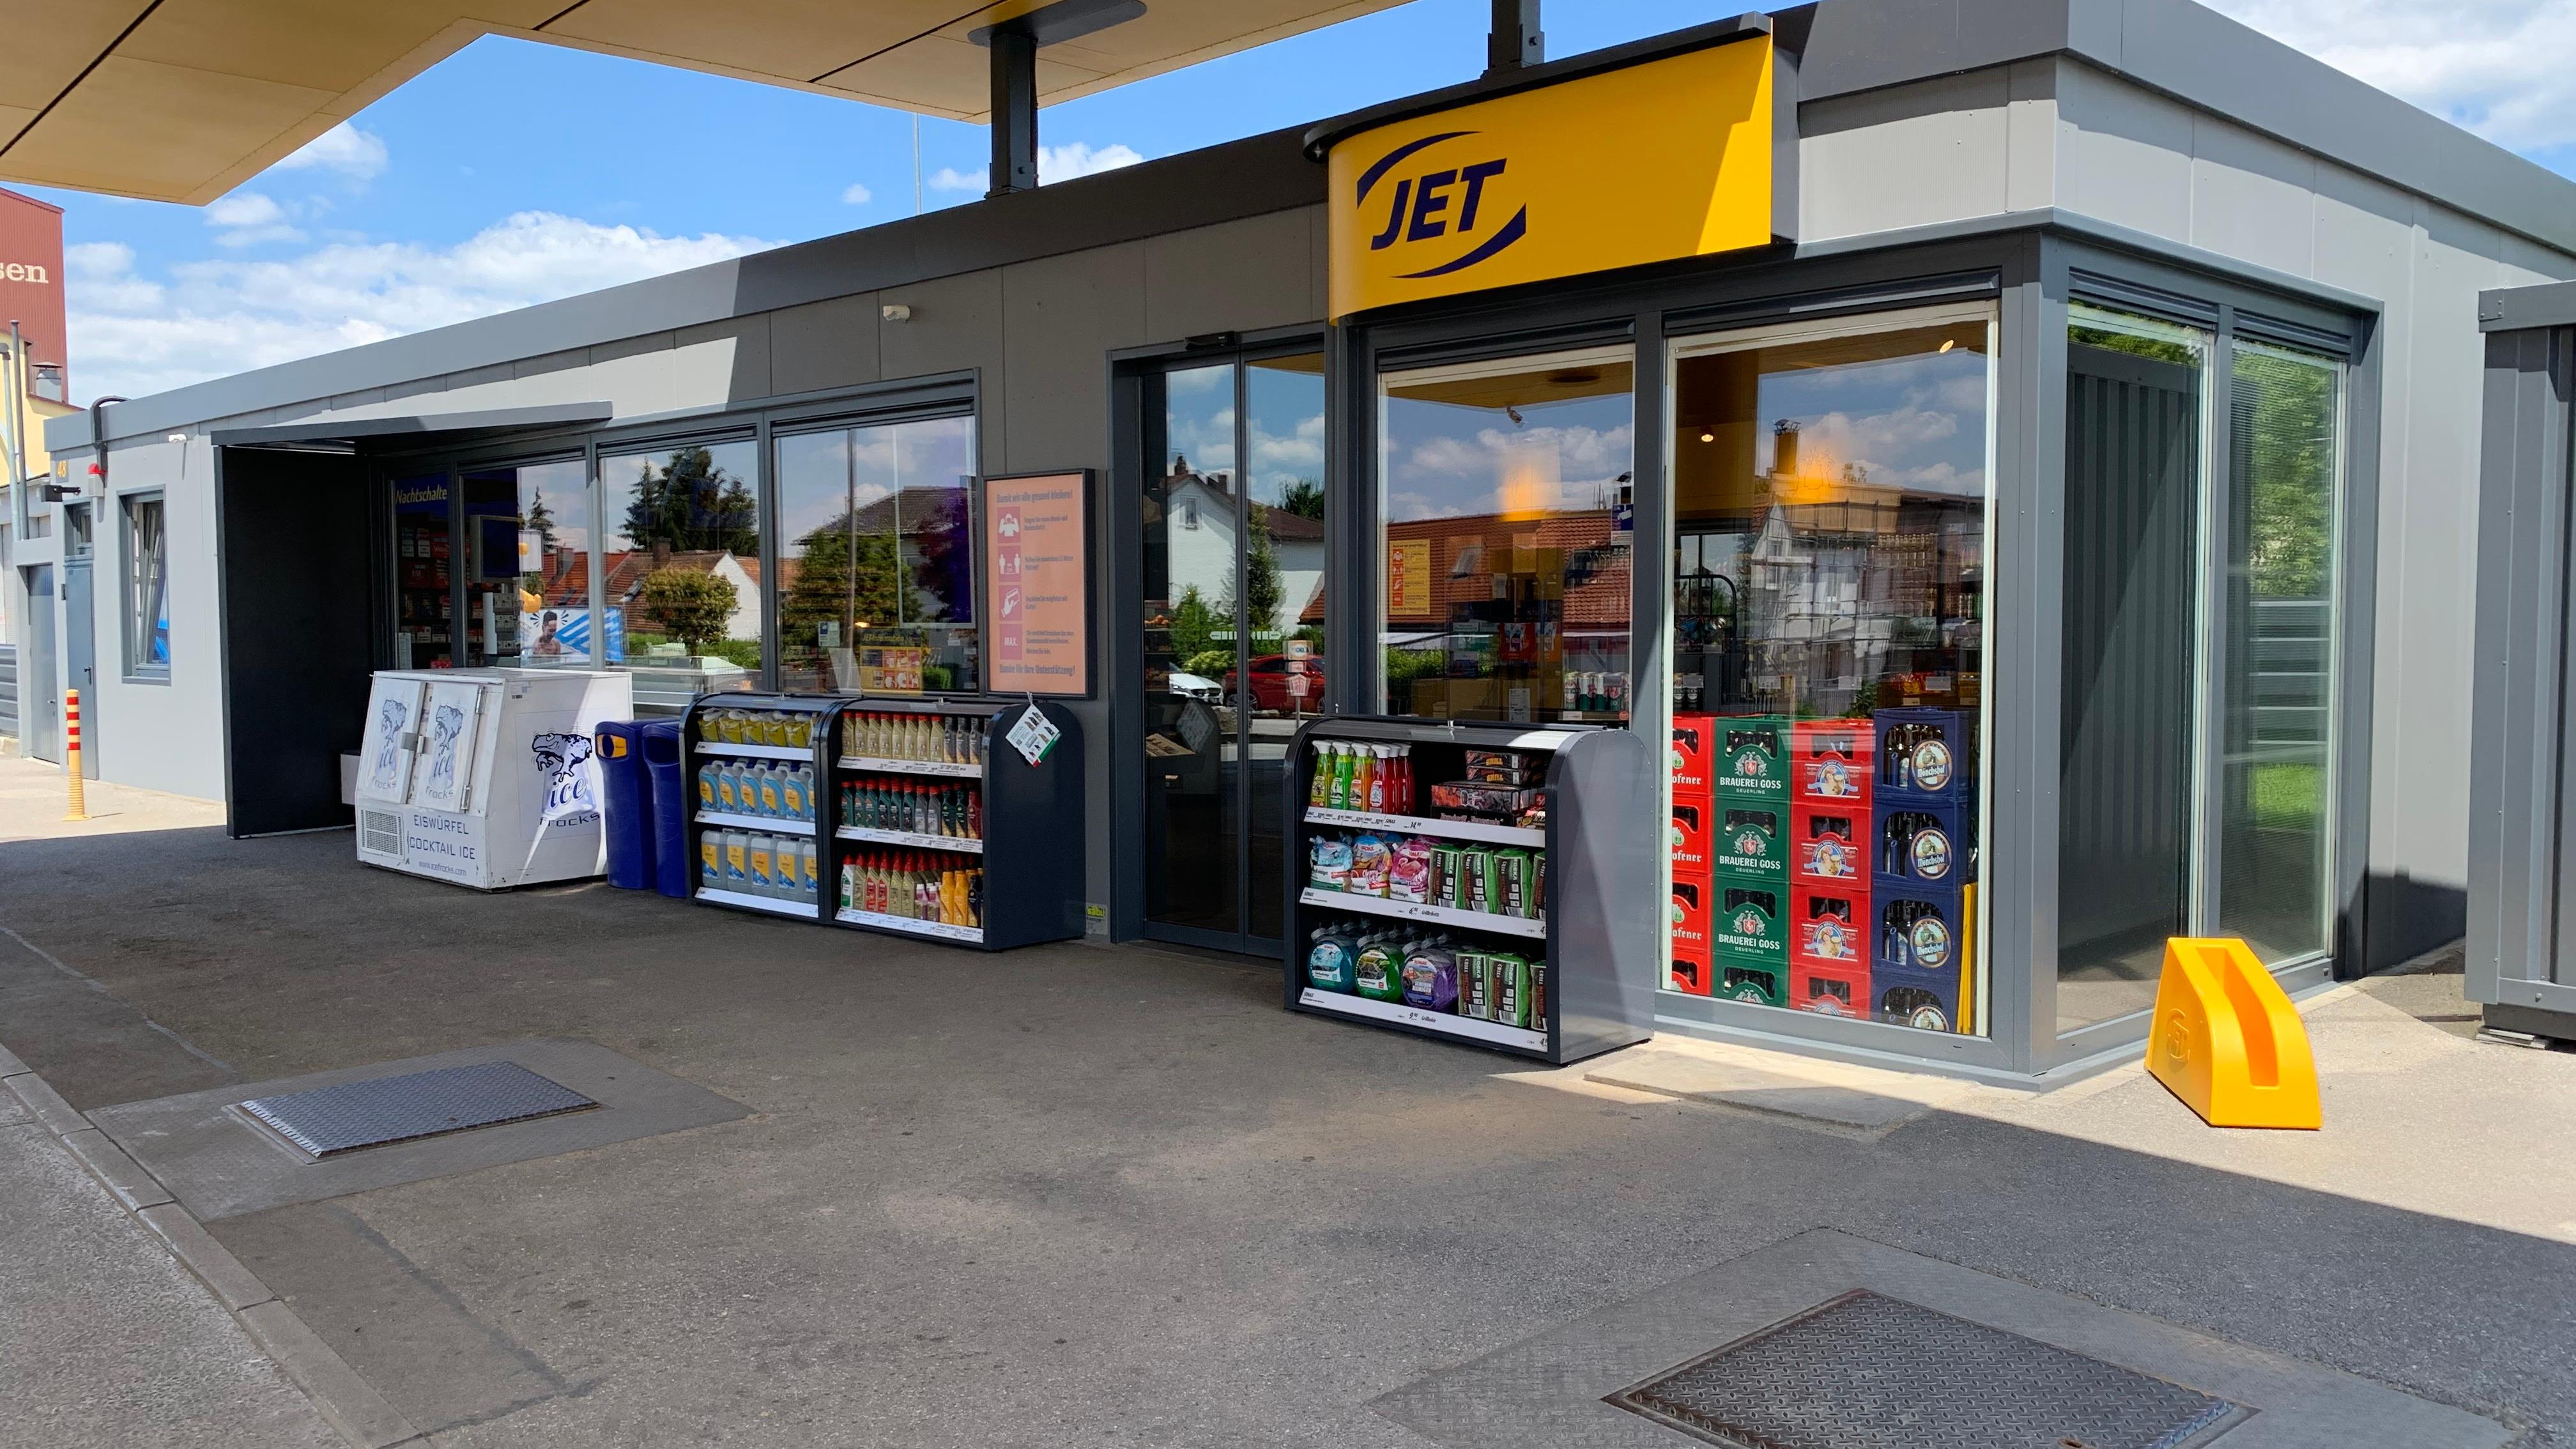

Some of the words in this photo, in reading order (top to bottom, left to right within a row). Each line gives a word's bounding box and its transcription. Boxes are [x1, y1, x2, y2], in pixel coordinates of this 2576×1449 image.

[1370, 158, 1507, 250] JET
[57, 460, 66, 478] 48
[1485, 757, 1503, 766] GRILL
[371, 775, 397, 790] frocks
[1486, 773, 1504, 782] GRILL
[1720, 776, 1758, 788] BRAUEREI
[1760, 779, 1782, 790] GOSS
[425, 786, 454, 800] frocks
[550, 778, 587, 808] ice
[414, 815, 470, 835] EISWÜRFEL
[539, 812, 600, 827] frocks
[410, 836, 456, 856] COCKTAIL
[459, 846, 475, 860] ICE
[418, 861, 467, 877] www.icefrocks.com
[1719, 854, 1758, 866] BRAUEREI
[1759, 858, 1781, 870] GOSS
[1718, 933, 1757, 946] BRAUEREI
[1758, 939, 1781, 950] GOSS
